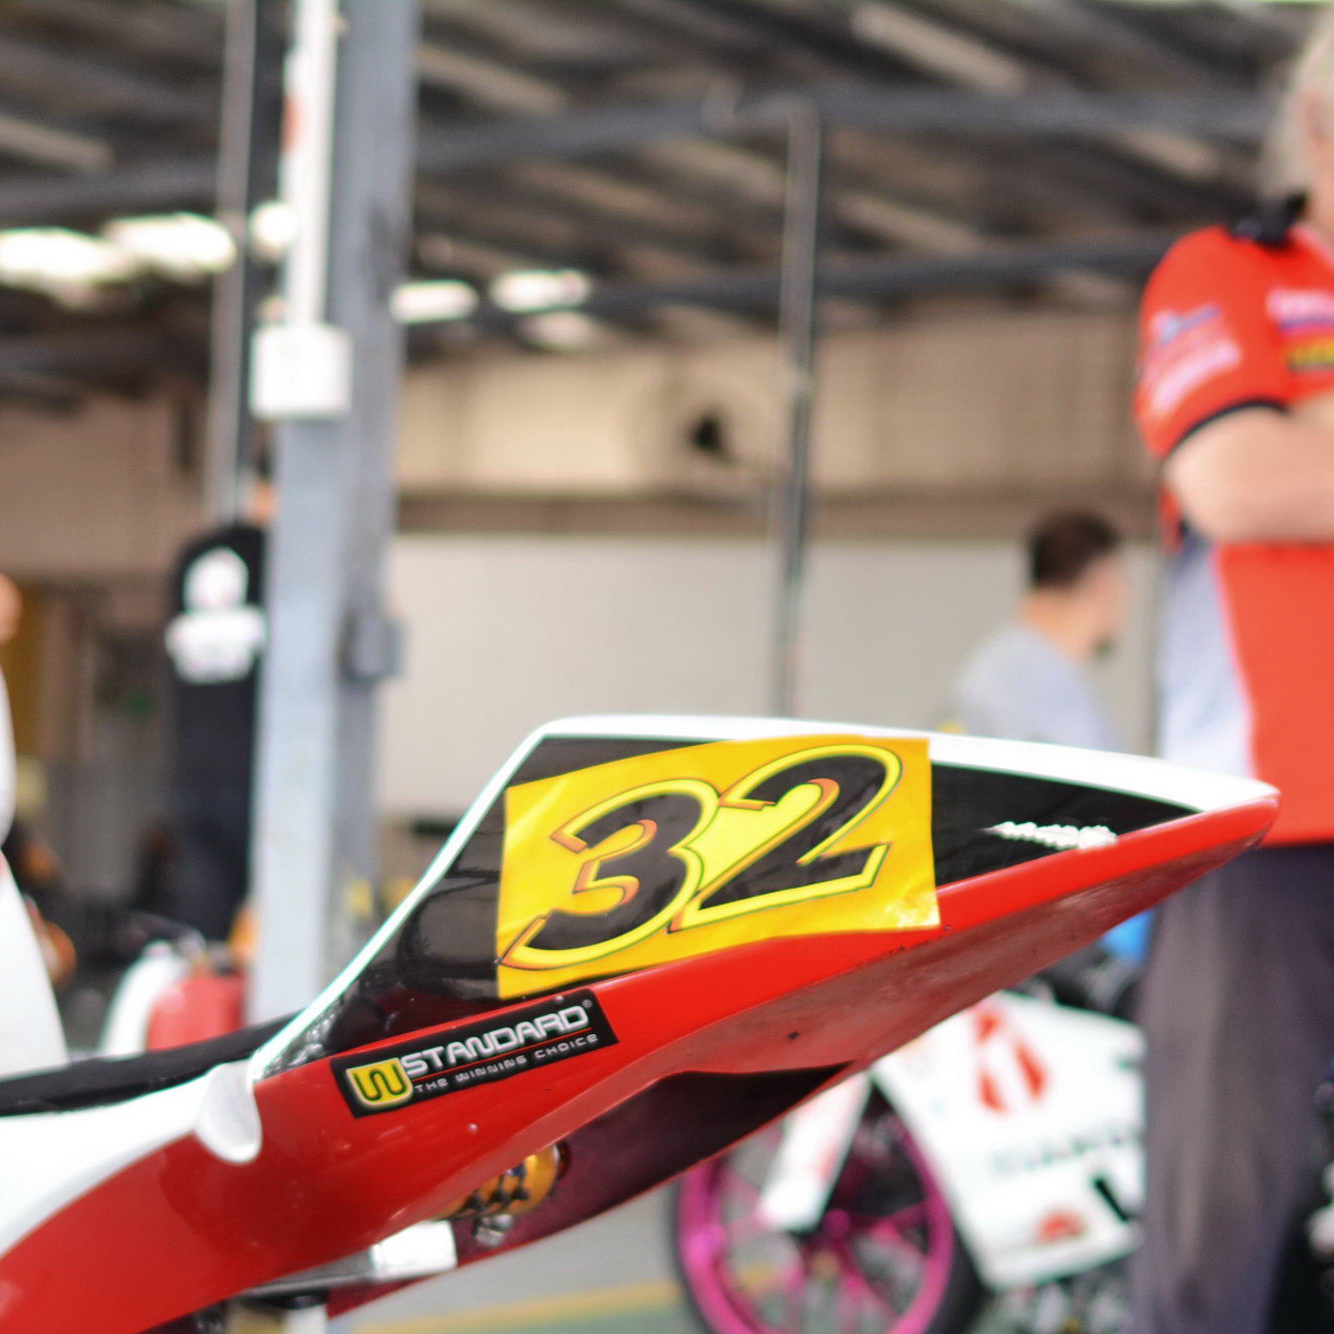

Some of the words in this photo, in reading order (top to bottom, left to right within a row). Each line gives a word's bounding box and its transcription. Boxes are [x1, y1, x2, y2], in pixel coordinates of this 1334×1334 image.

[497, 744, 902, 970] 32
[400, 1005, 589, 1077] STANDARD
[415, 1077, 449, 1094] THE
[455, 1055, 527, 1083] WINNING
[534, 1032, 599, 1060] CHOICE
